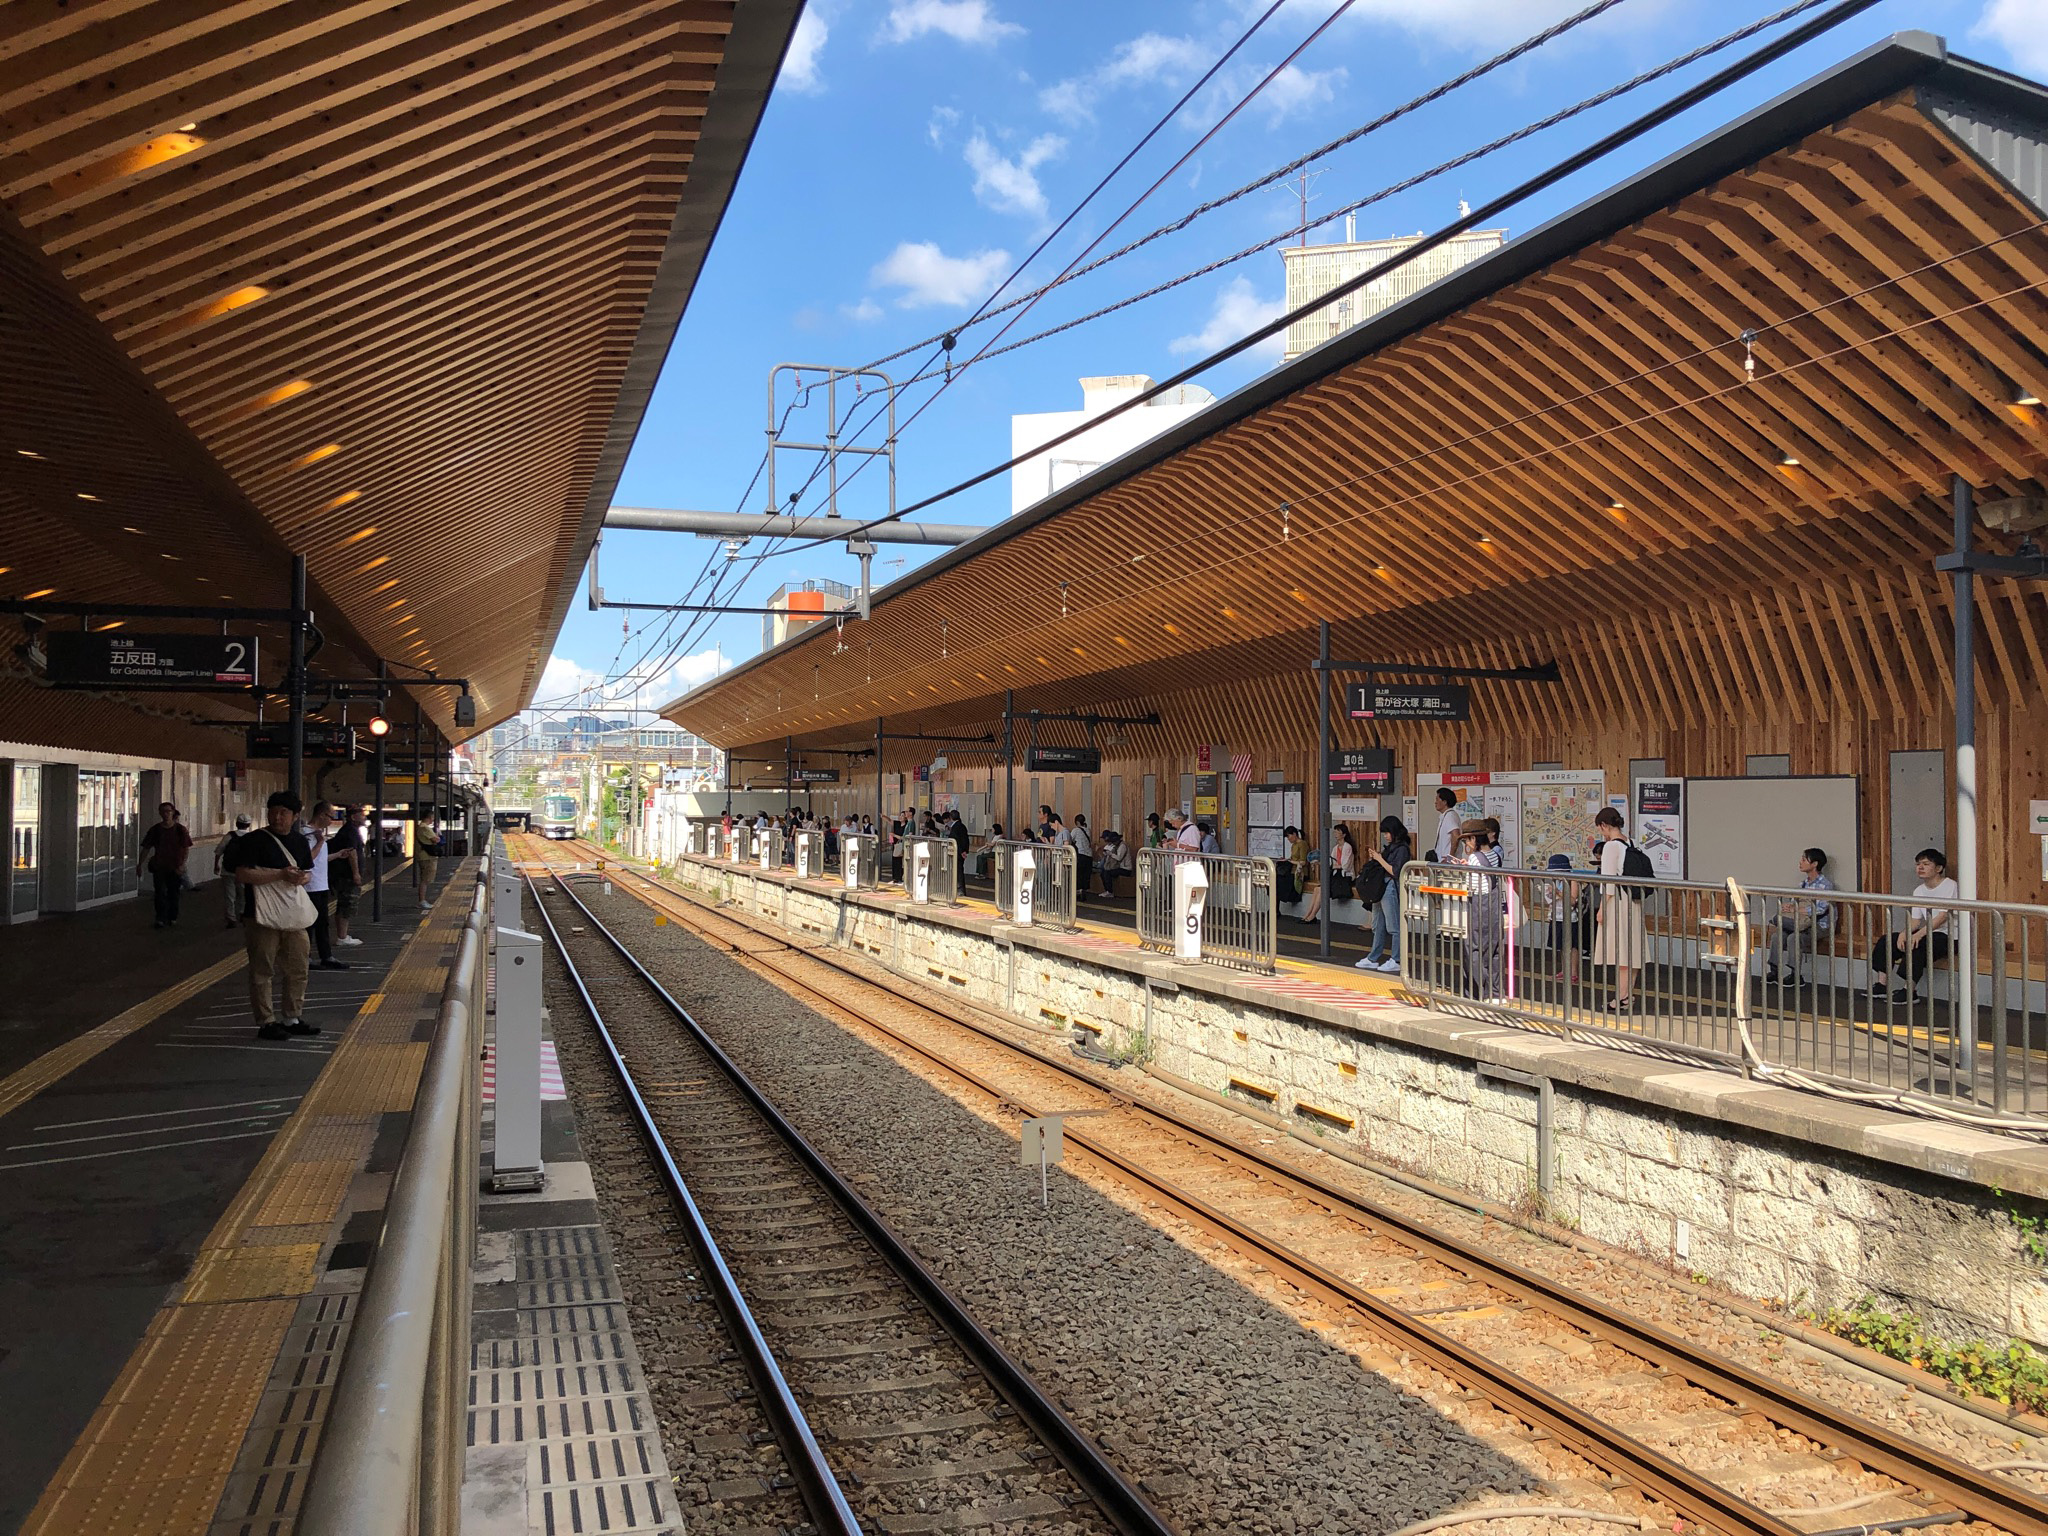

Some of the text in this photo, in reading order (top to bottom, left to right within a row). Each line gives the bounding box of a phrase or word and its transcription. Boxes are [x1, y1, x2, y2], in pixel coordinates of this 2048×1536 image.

[110, 651, 156, 666] 五反田
[224, 642, 246, 673] 2
[110, 666, 214, 678] for Gotanda (Ikegami Line)
[1358, 688, 1366, 711] 1
[1374, 696, 1420, 708] 雪が谷大塚
[1422, 698, 1440, 709] 蒲田
[338, 733, 346, 744] 2
[732, 844, 738, 855] 3
[762, 850, 768, 860] 4
[800, 854, 806, 866] 5
[848, 866, 856, 876] 6
[918, 874, 927, 888] 7
[1020, 890, 1030, 906] 8
[1186, 916, 1199, 935] 9
